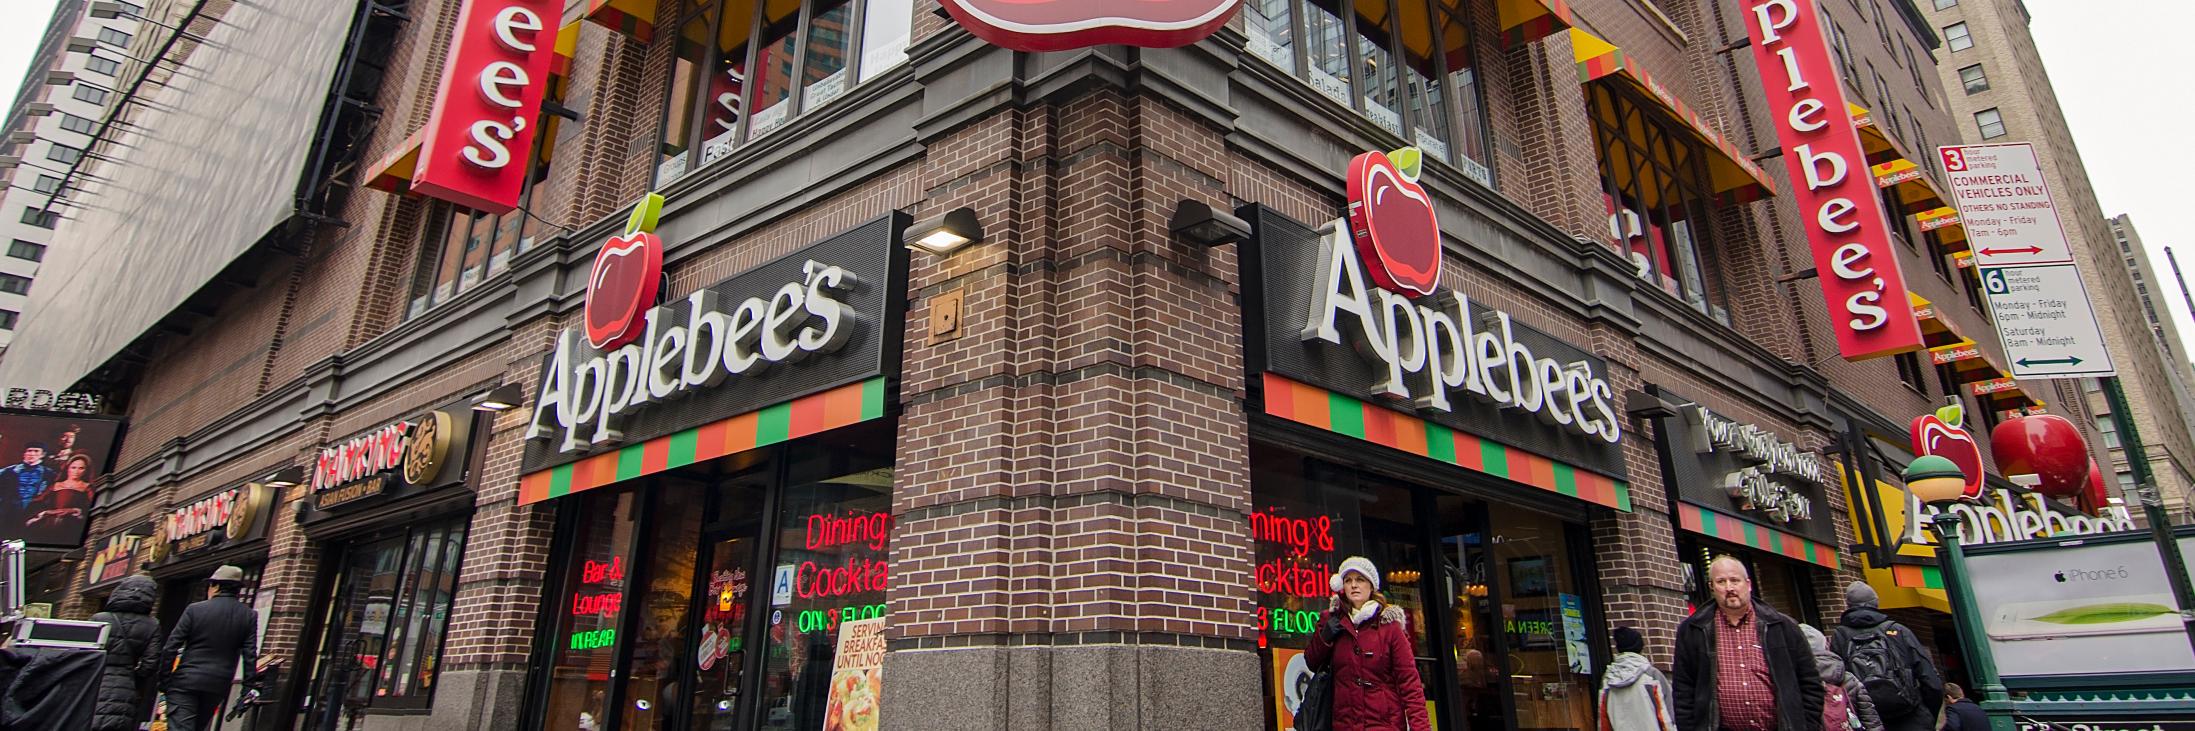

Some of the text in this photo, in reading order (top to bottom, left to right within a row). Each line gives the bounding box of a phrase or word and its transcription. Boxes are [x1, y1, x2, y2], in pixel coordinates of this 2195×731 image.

[1945, 150, 1963, 170] 3
[1968, 161, 1997, 170] parking
[1953, 174, 2029, 186] COMMERCIAL
[1957, 186, 2044, 199] VEHICLES ONLY
[1962, 201, 2050, 213] OTHERS NO STANDING
[1967, 217, 2001, 227] Monday
[2009, 216, 2037, 225] Friday
[1970, 229, 1990, 237] 7am
[1997, 228, 2018, 237] 6pm
[1986, 270, 2004, 293] 6
[1994, 300, 2030, 310] Monday
[2038, 300, 2067, 309] Friday
[1999, 313, 2019, 322] 6pm
[2027, 310, 2066, 320] Midnight
[1303, 216, 1621, 444] Applebee's
[2003, 327, 2045, 336] Saturday
[2007, 338, 2028, 347] 8am
[2036, 336, 2076, 347] Midnight
[526, 259, 857, 453] Applebee's
[0, 387, 101, 415] RDEN
[805, 511, 888, 550] Dining
[1249, 506, 1334, 556] ning &
[583, 556, 623, 584] Bar &
[797, 557, 888, 599] Cockta
[1255, 558, 1333, 599] cktail
[2069, 566, 2129, 582] iPhone 6
[777, 570, 789, 594] A
[572, 592, 622, 618] Lounge
[799, 604, 887, 633] ON 3 FLOO
[1257, 606, 1320, 635] 3 FLOO
[570, 628, 616, 650] IN REAR
[851, 622, 885, 639] SERVIN
[843, 637, 887, 654] BREAKFA
[837, 651, 885, 669] UNTIL NOO
